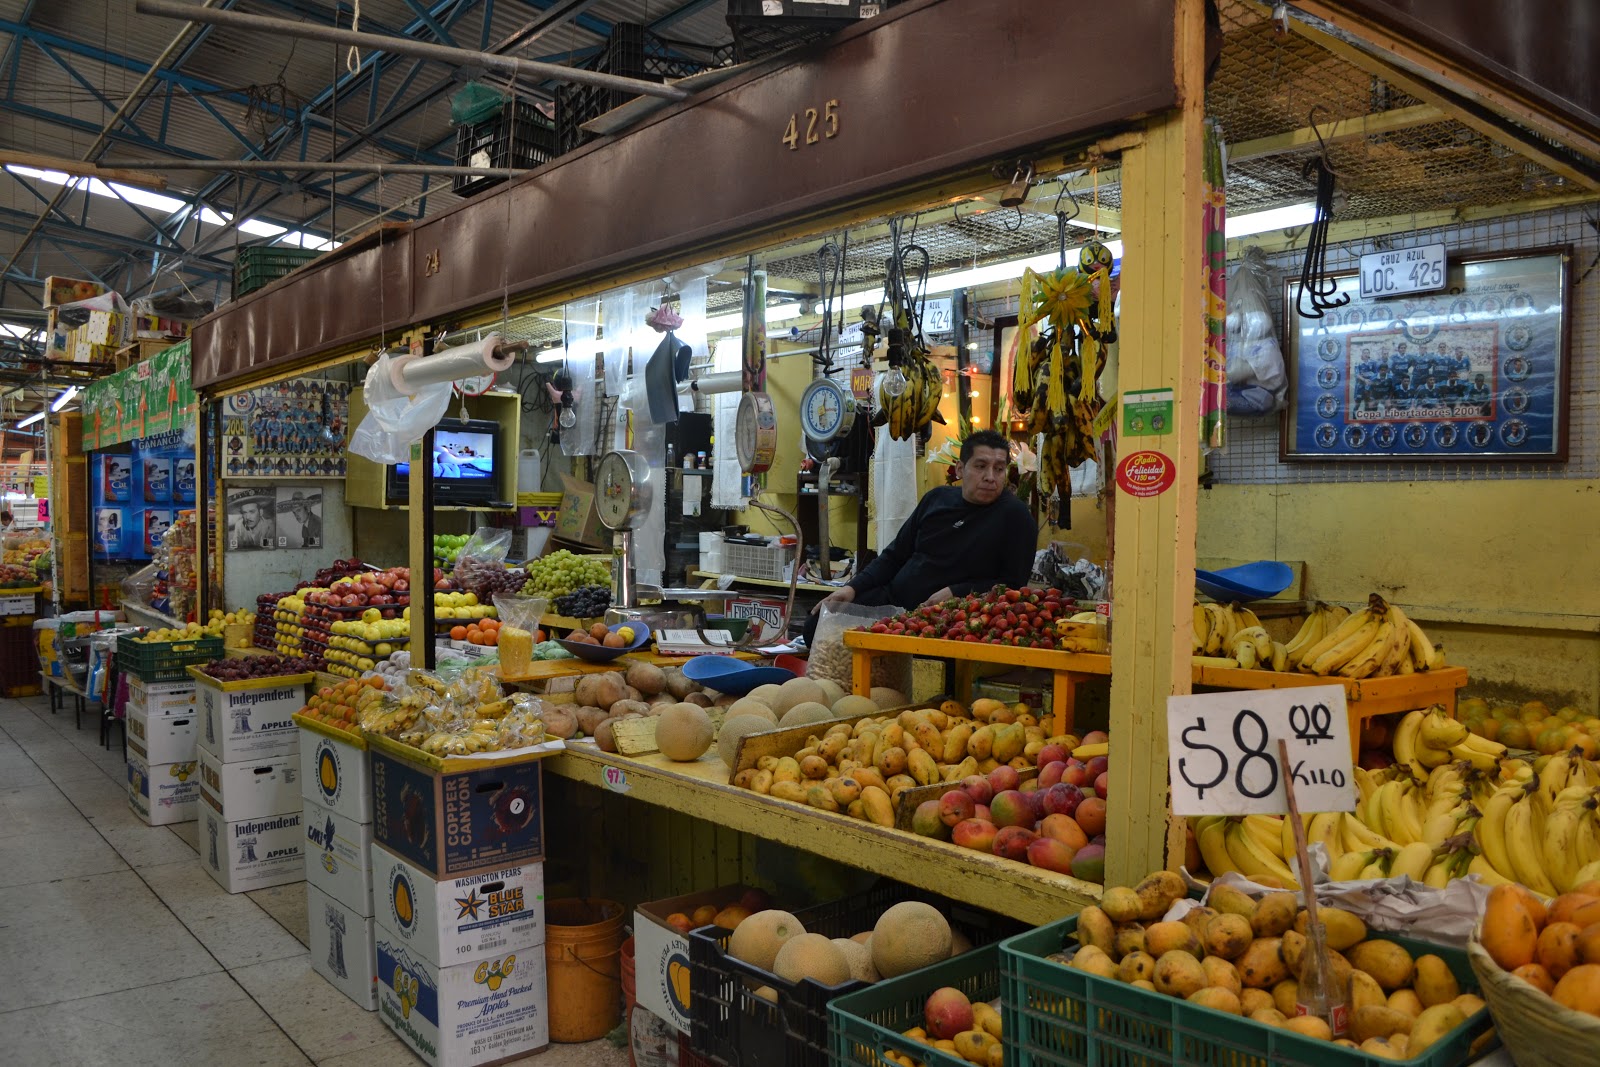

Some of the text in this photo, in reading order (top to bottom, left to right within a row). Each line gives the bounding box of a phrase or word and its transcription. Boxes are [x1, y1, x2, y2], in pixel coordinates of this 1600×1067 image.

[861, 8, 877, 16] 2674
[782, 99, 838, 150] 425
[1380, 250, 1426, 266] CRUZ AZUL
[1362, 260, 1442, 294] LOC. 425
[928, 301, 941, 310] AZUL
[930, 309, 950, 330] 424
[1356, 406, 1481, 419] Copa Libertadores 2001
[138, 435, 181, 450] GANANCIA
[1134, 454, 1157, 466] Radio
[1125, 464, 1165, 478] Felicidad
[733, 603, 779, 626] FIRST FRUITS
[229, 687, 296, 708] Independent
[260, 720, 293, 731] APPLES
[1178, 709, 1279, 801] $8
[1291, 759, 1346, 788] KILO
[445, 779, 459, 847] COPPER
[459, 776, 472, 846] CANYON
[235, 815, 301, 838] Independent
[266, 846, 299, 859] APPLES
[455, 867, 522, 889] WASHINGTON PEARS
[487, 886, 524, 906] BLUE
[488, 899, 526, 919] STAR
[455, 944, 473, 955] 100
[457, 982, 533, 1011] Premium Hand Packed
[474, 999, 511, 1019] Apples
[456, 1020, 476, 1029] PRODUCE
[470, 1045, 481, 1056] 163
[488, 1041, 502, 1050] Golden
[502, 1036, 522, 1048] Delicious
[474, 1038, 487, 1046] WASH
[487, 1035, 493, 1043] EX
[492, 1032, 506, 1041] FANCY
[506, 1026, 525, 1037] PREMIUM
